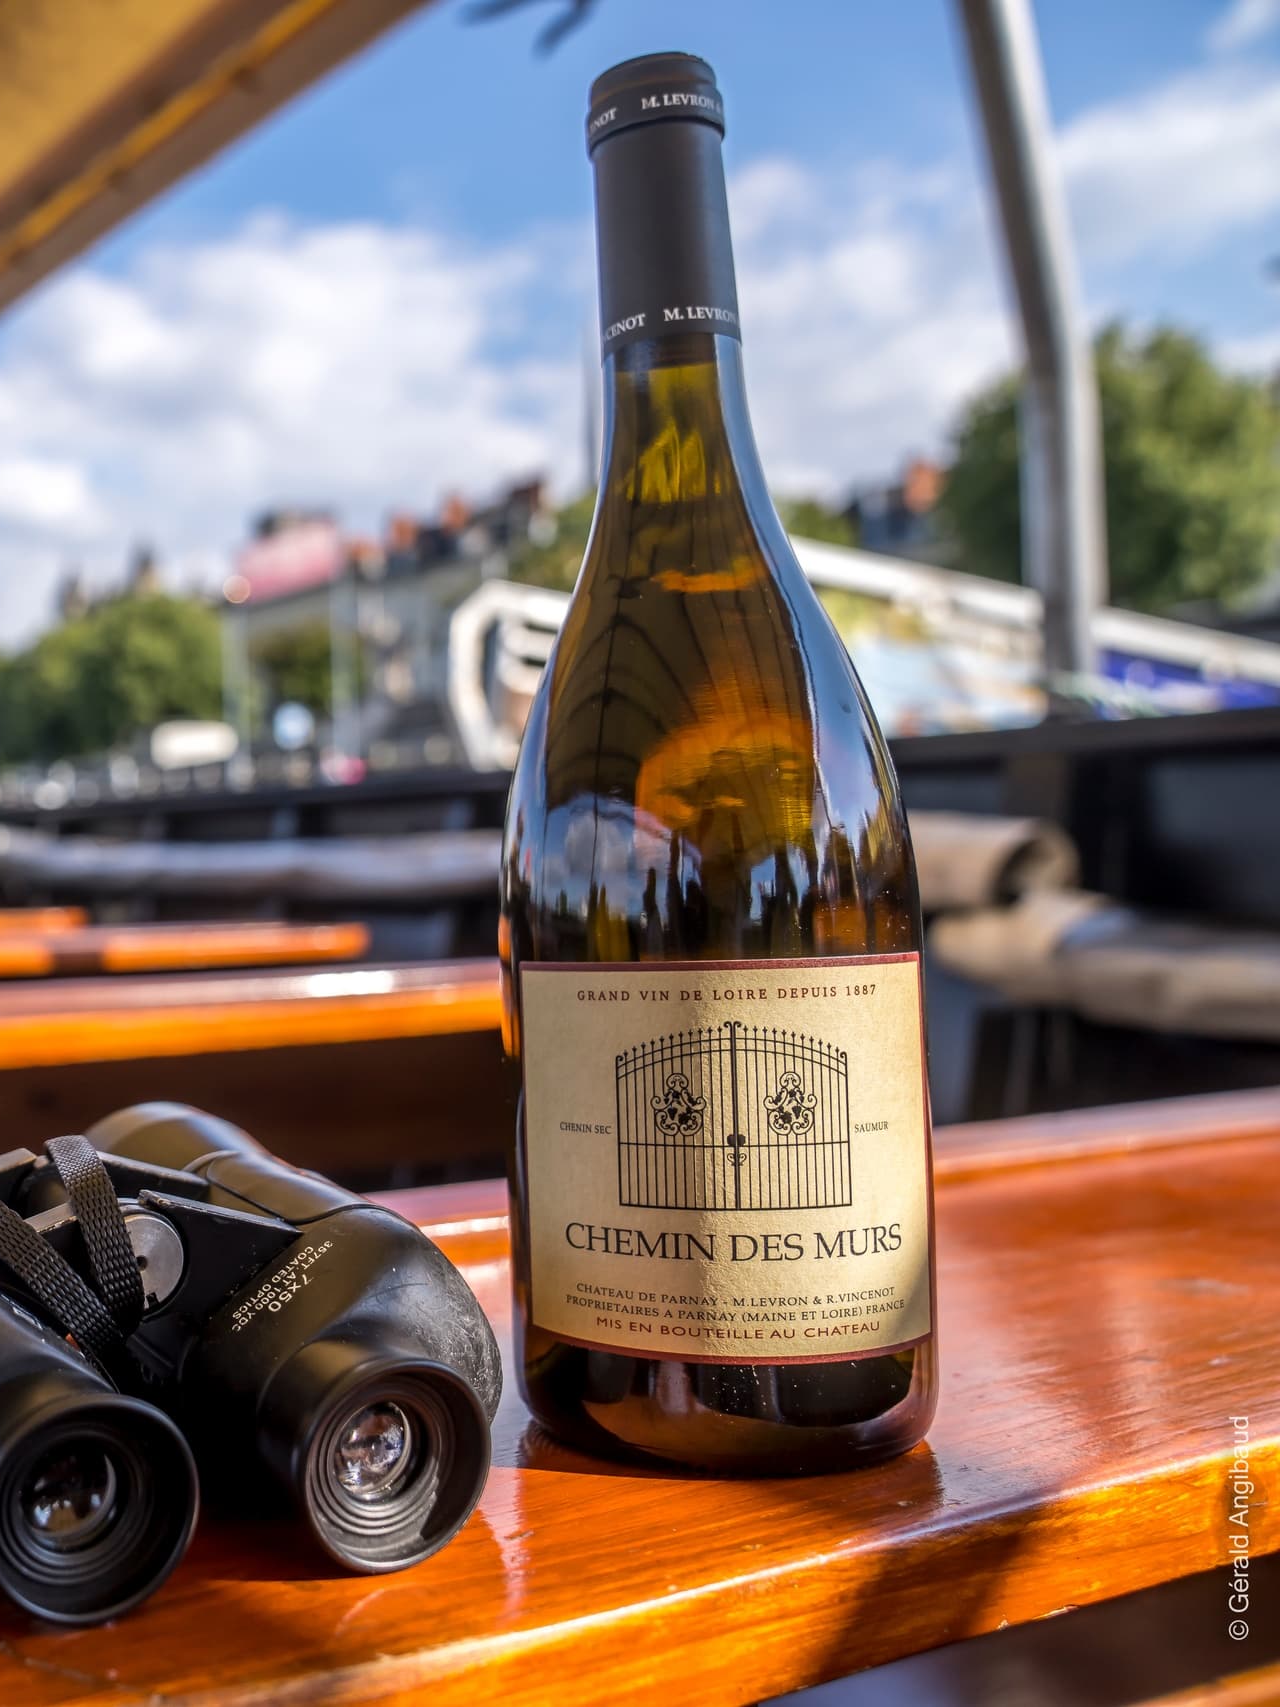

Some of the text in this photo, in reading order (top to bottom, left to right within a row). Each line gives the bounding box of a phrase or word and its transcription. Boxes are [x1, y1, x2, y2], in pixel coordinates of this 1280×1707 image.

[641, 95, 661, 110] M.
[663, 93, 715, 111] LEVRON
[590, 107, 617, 131] NOT
[663, 307, 684, 322] M.
[577, 984, 877, 1001] GRAND VIN DE LOIRE DEPUIS 1887
[559, 1121, 612, 1135] CHENIN SEC
[854, 1120, 889, 1133] SAUMUR
[565, 1222, 902, 1262] CHEMIN DES MURS
[232, 1246, 314, 1320] COATED OPTICS
[282, 1271, 296, 1287] AT
[255, 1286, 282, 1311] 1000
[576, 1283, 634, 1300] CHATEAU
[638, 1292, 657, 1303] DE
[661, 1294, 718, 1306] PARNAY
[813, 1295, 822, 1305] &
[566, 1294, 905, 1323] PROPRIETAIRES A PARNAY (MAINE ET LOIRE) FRANCE
[596, 1316, 880, 1340] MIS EN BOUTEILLE AU CHATEAU
